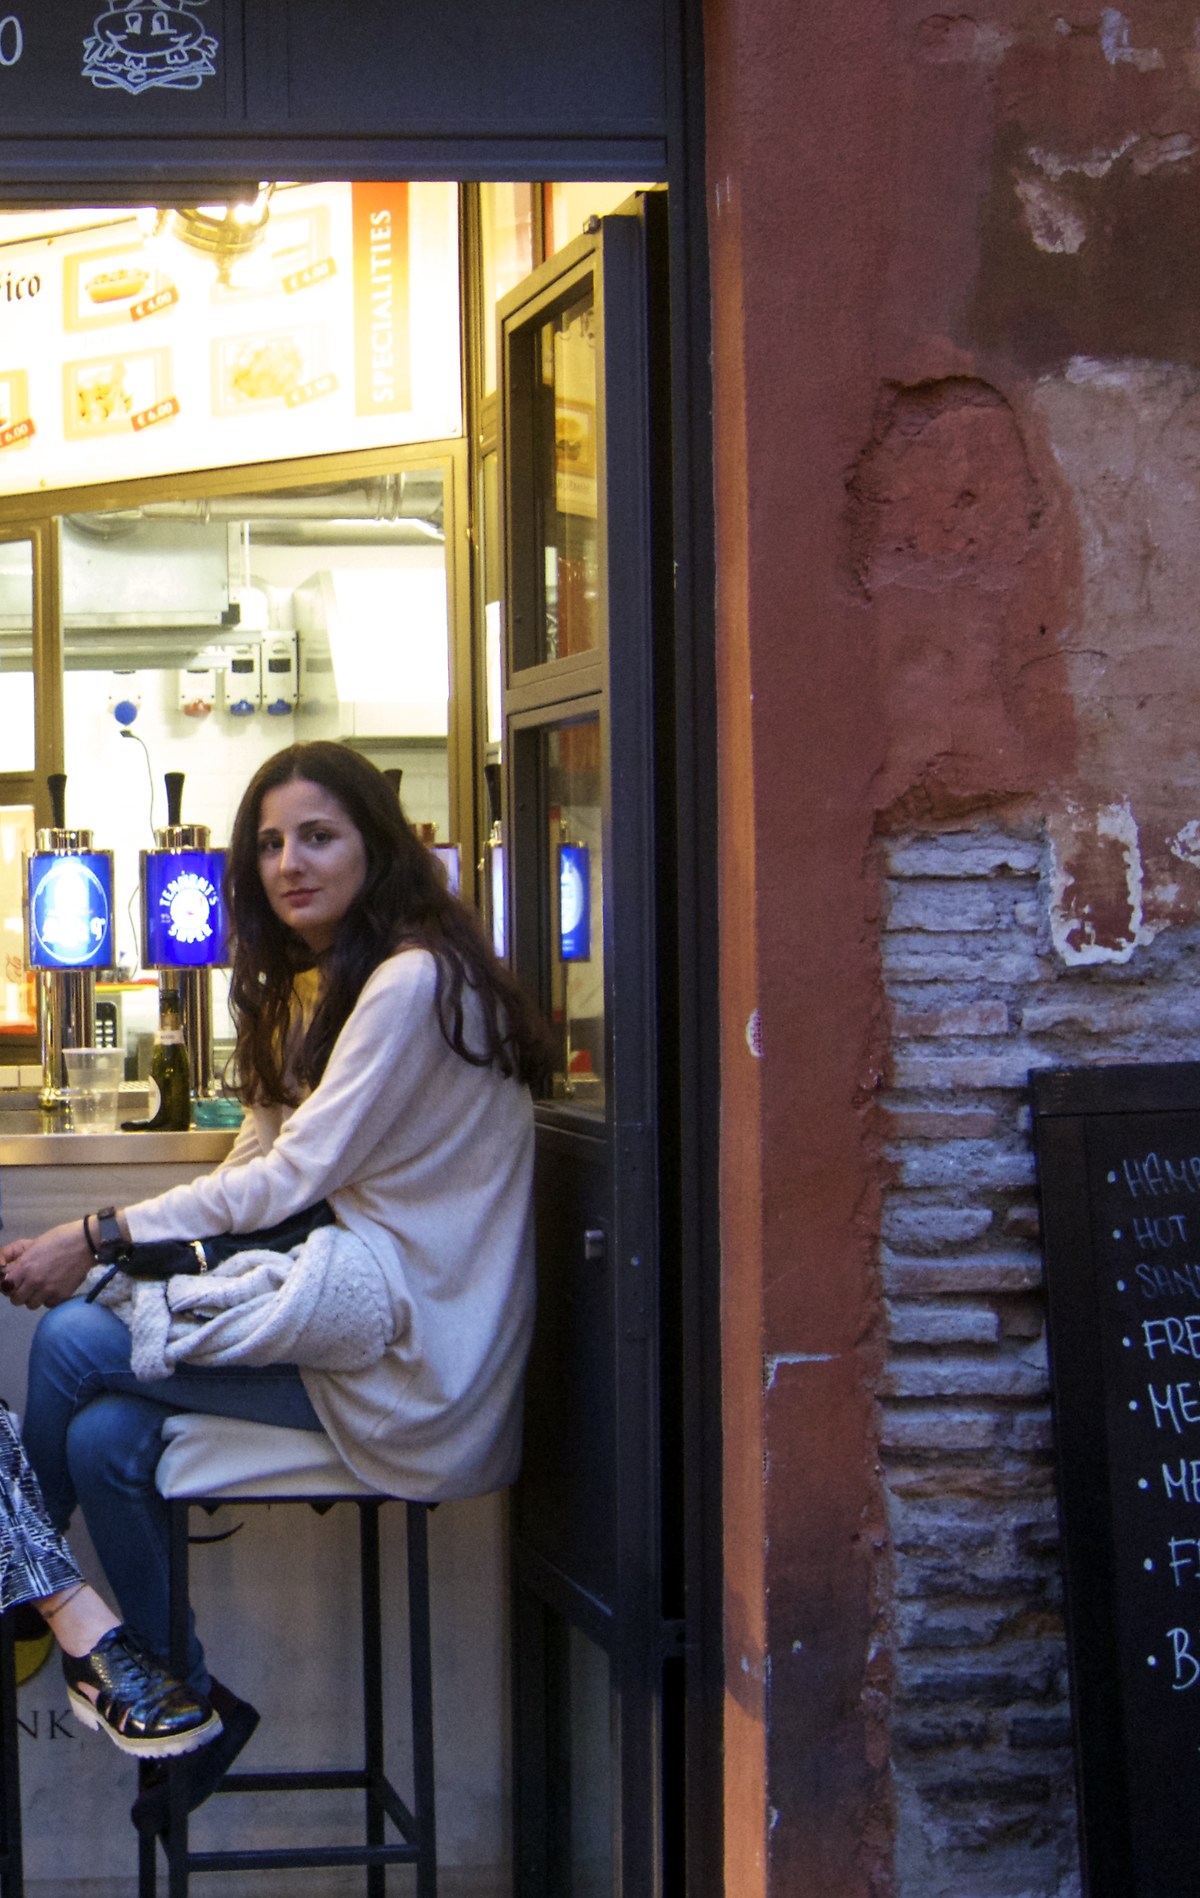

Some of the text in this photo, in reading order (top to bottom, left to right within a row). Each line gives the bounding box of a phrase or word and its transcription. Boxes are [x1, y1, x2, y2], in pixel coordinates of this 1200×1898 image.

[370, 209, 393, 403] SPECIALITIES
[1132, 1214, 1188, 1249] HOT
[1135, 1262, 1200, 1299] SAN
